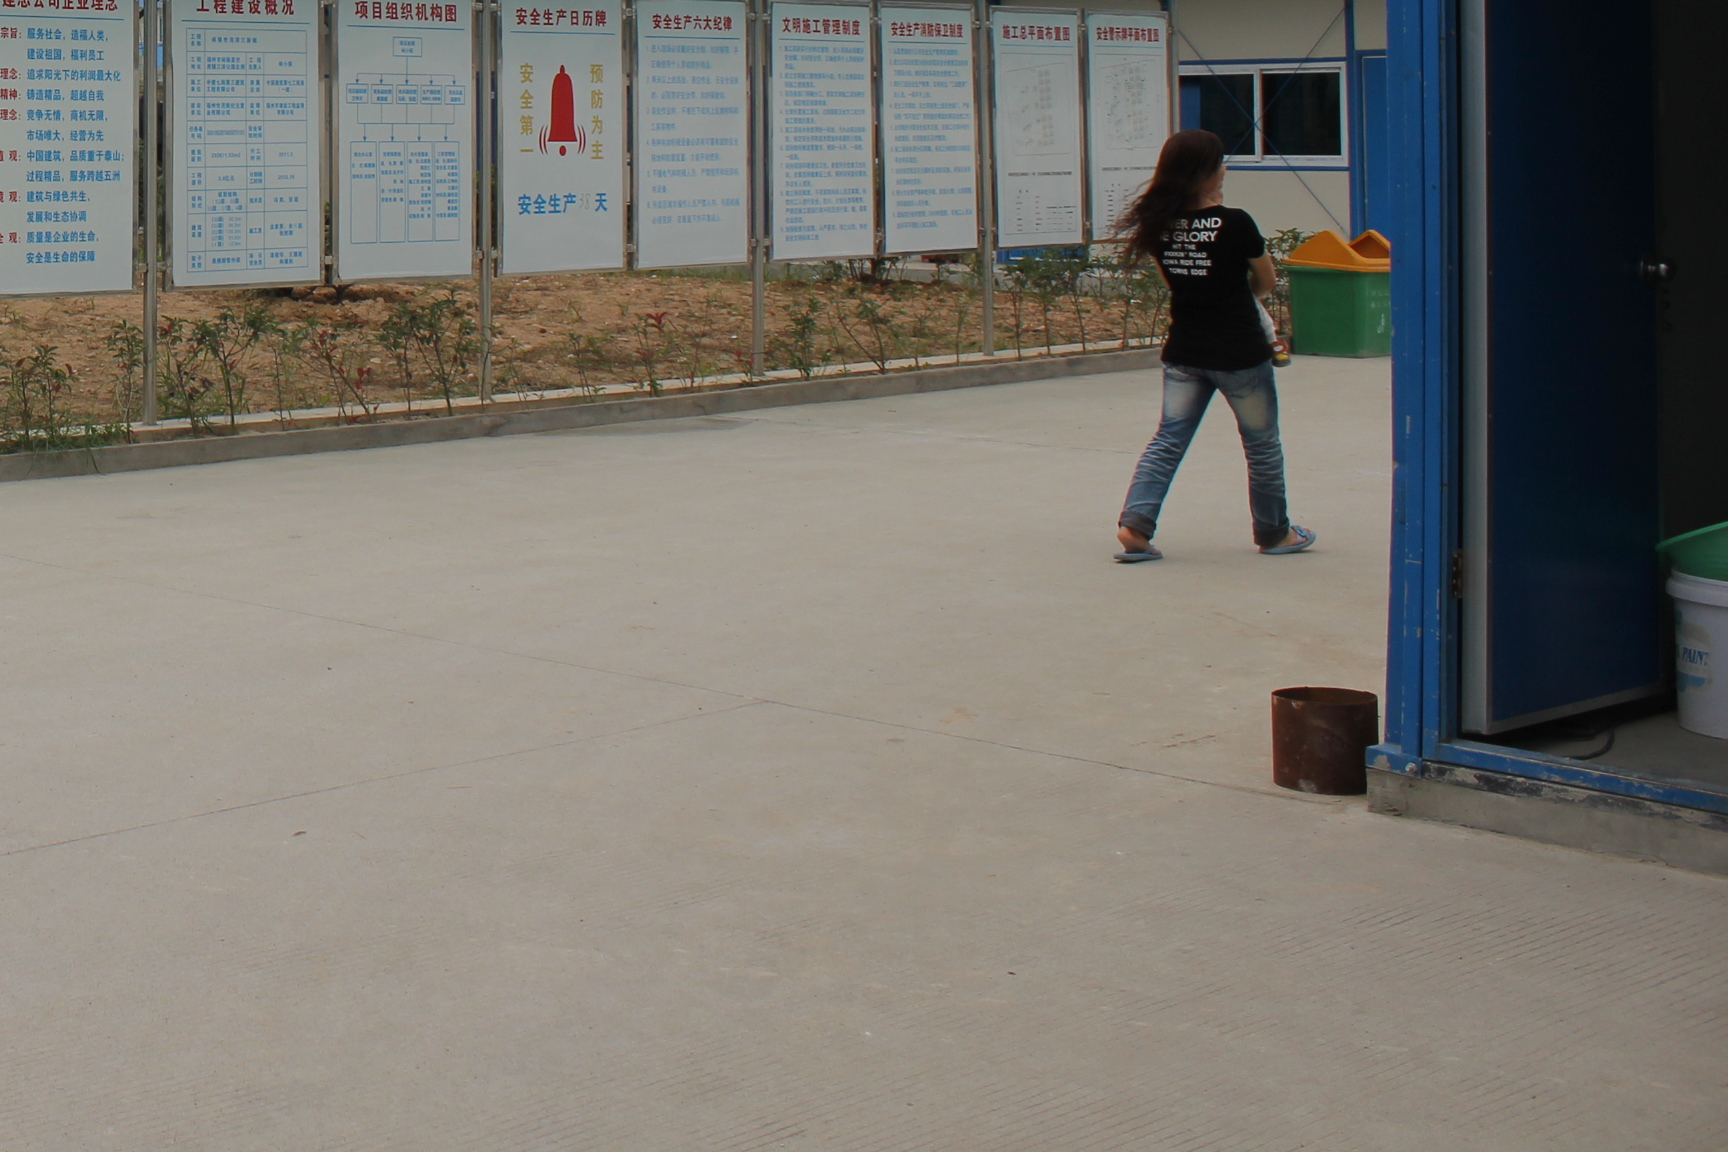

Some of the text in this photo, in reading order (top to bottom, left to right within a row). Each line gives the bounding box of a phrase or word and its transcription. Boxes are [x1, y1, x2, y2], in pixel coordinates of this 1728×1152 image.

[355, 0, 457, 22] 项目组织机构图
[515, 7, 607, 28] 安全生产日历牌
[652, 13, 733, 31] 安全生产六大纪律
[782, 16, 861, 36] 文明施工管理制度
[891, 21, 964, 39] 安全生产消防保卫制度
[1002, 25, 1071, 42] 施工总平面布置图
[1096, 27, 1159, 43] 安全警示牌平面布置图
[519, 62, 534, 154] 安全第一
[590, 63, 604, 160] 预防为主
[1191, 217, 1221, 229] AND
[1172, 231, 1218, 242] GLORY
